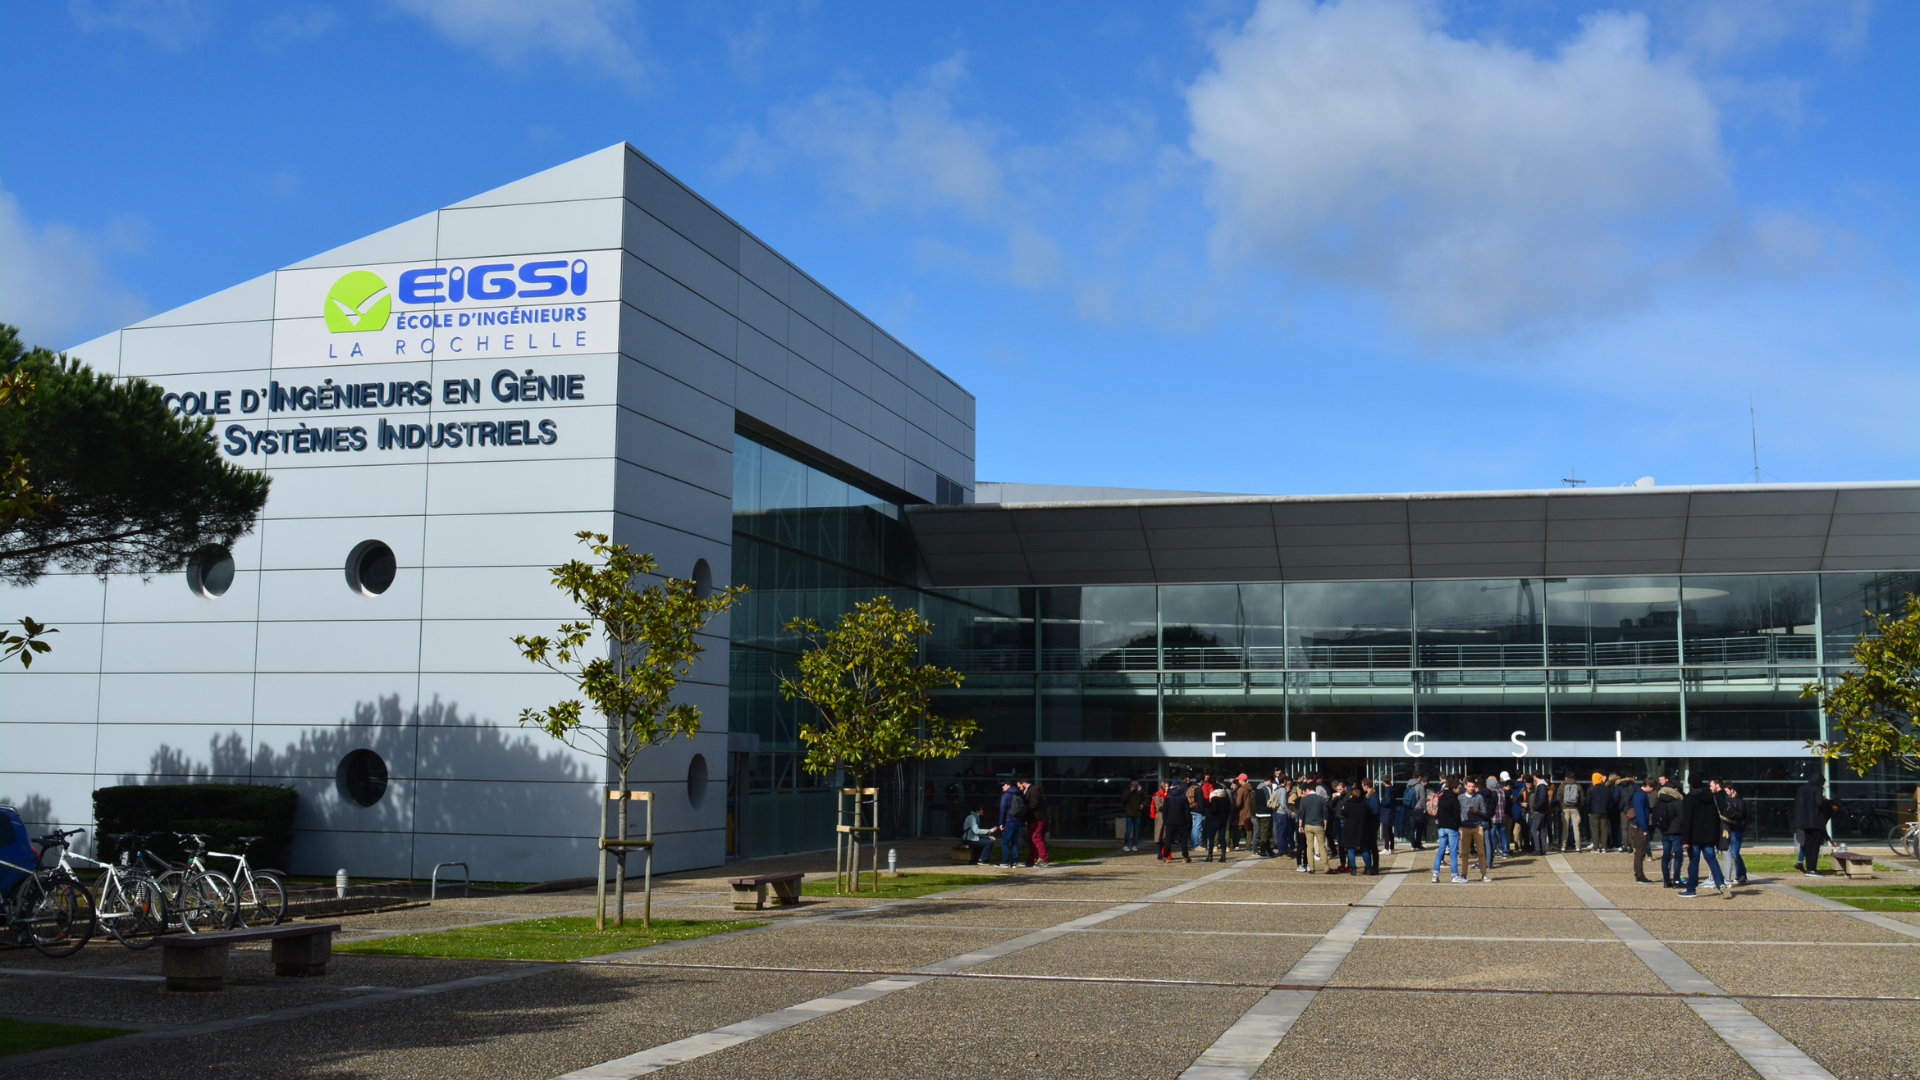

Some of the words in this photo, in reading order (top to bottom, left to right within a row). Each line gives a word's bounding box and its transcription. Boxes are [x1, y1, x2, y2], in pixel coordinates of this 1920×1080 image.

[396, 311, 453, 330] ÉCOLE
[328, 342, 364, 358] LA
[396, 330, 587, 355] ROCHELLE
[146, 387, 232, 417] COLE
[442, 378, 481, 404] EN
[490, 368, 586, 403] GÉNIE
[223, 424, 368, 456] SYSTÈMES
[377, 418, 558, 450] INDUSTRIELS
